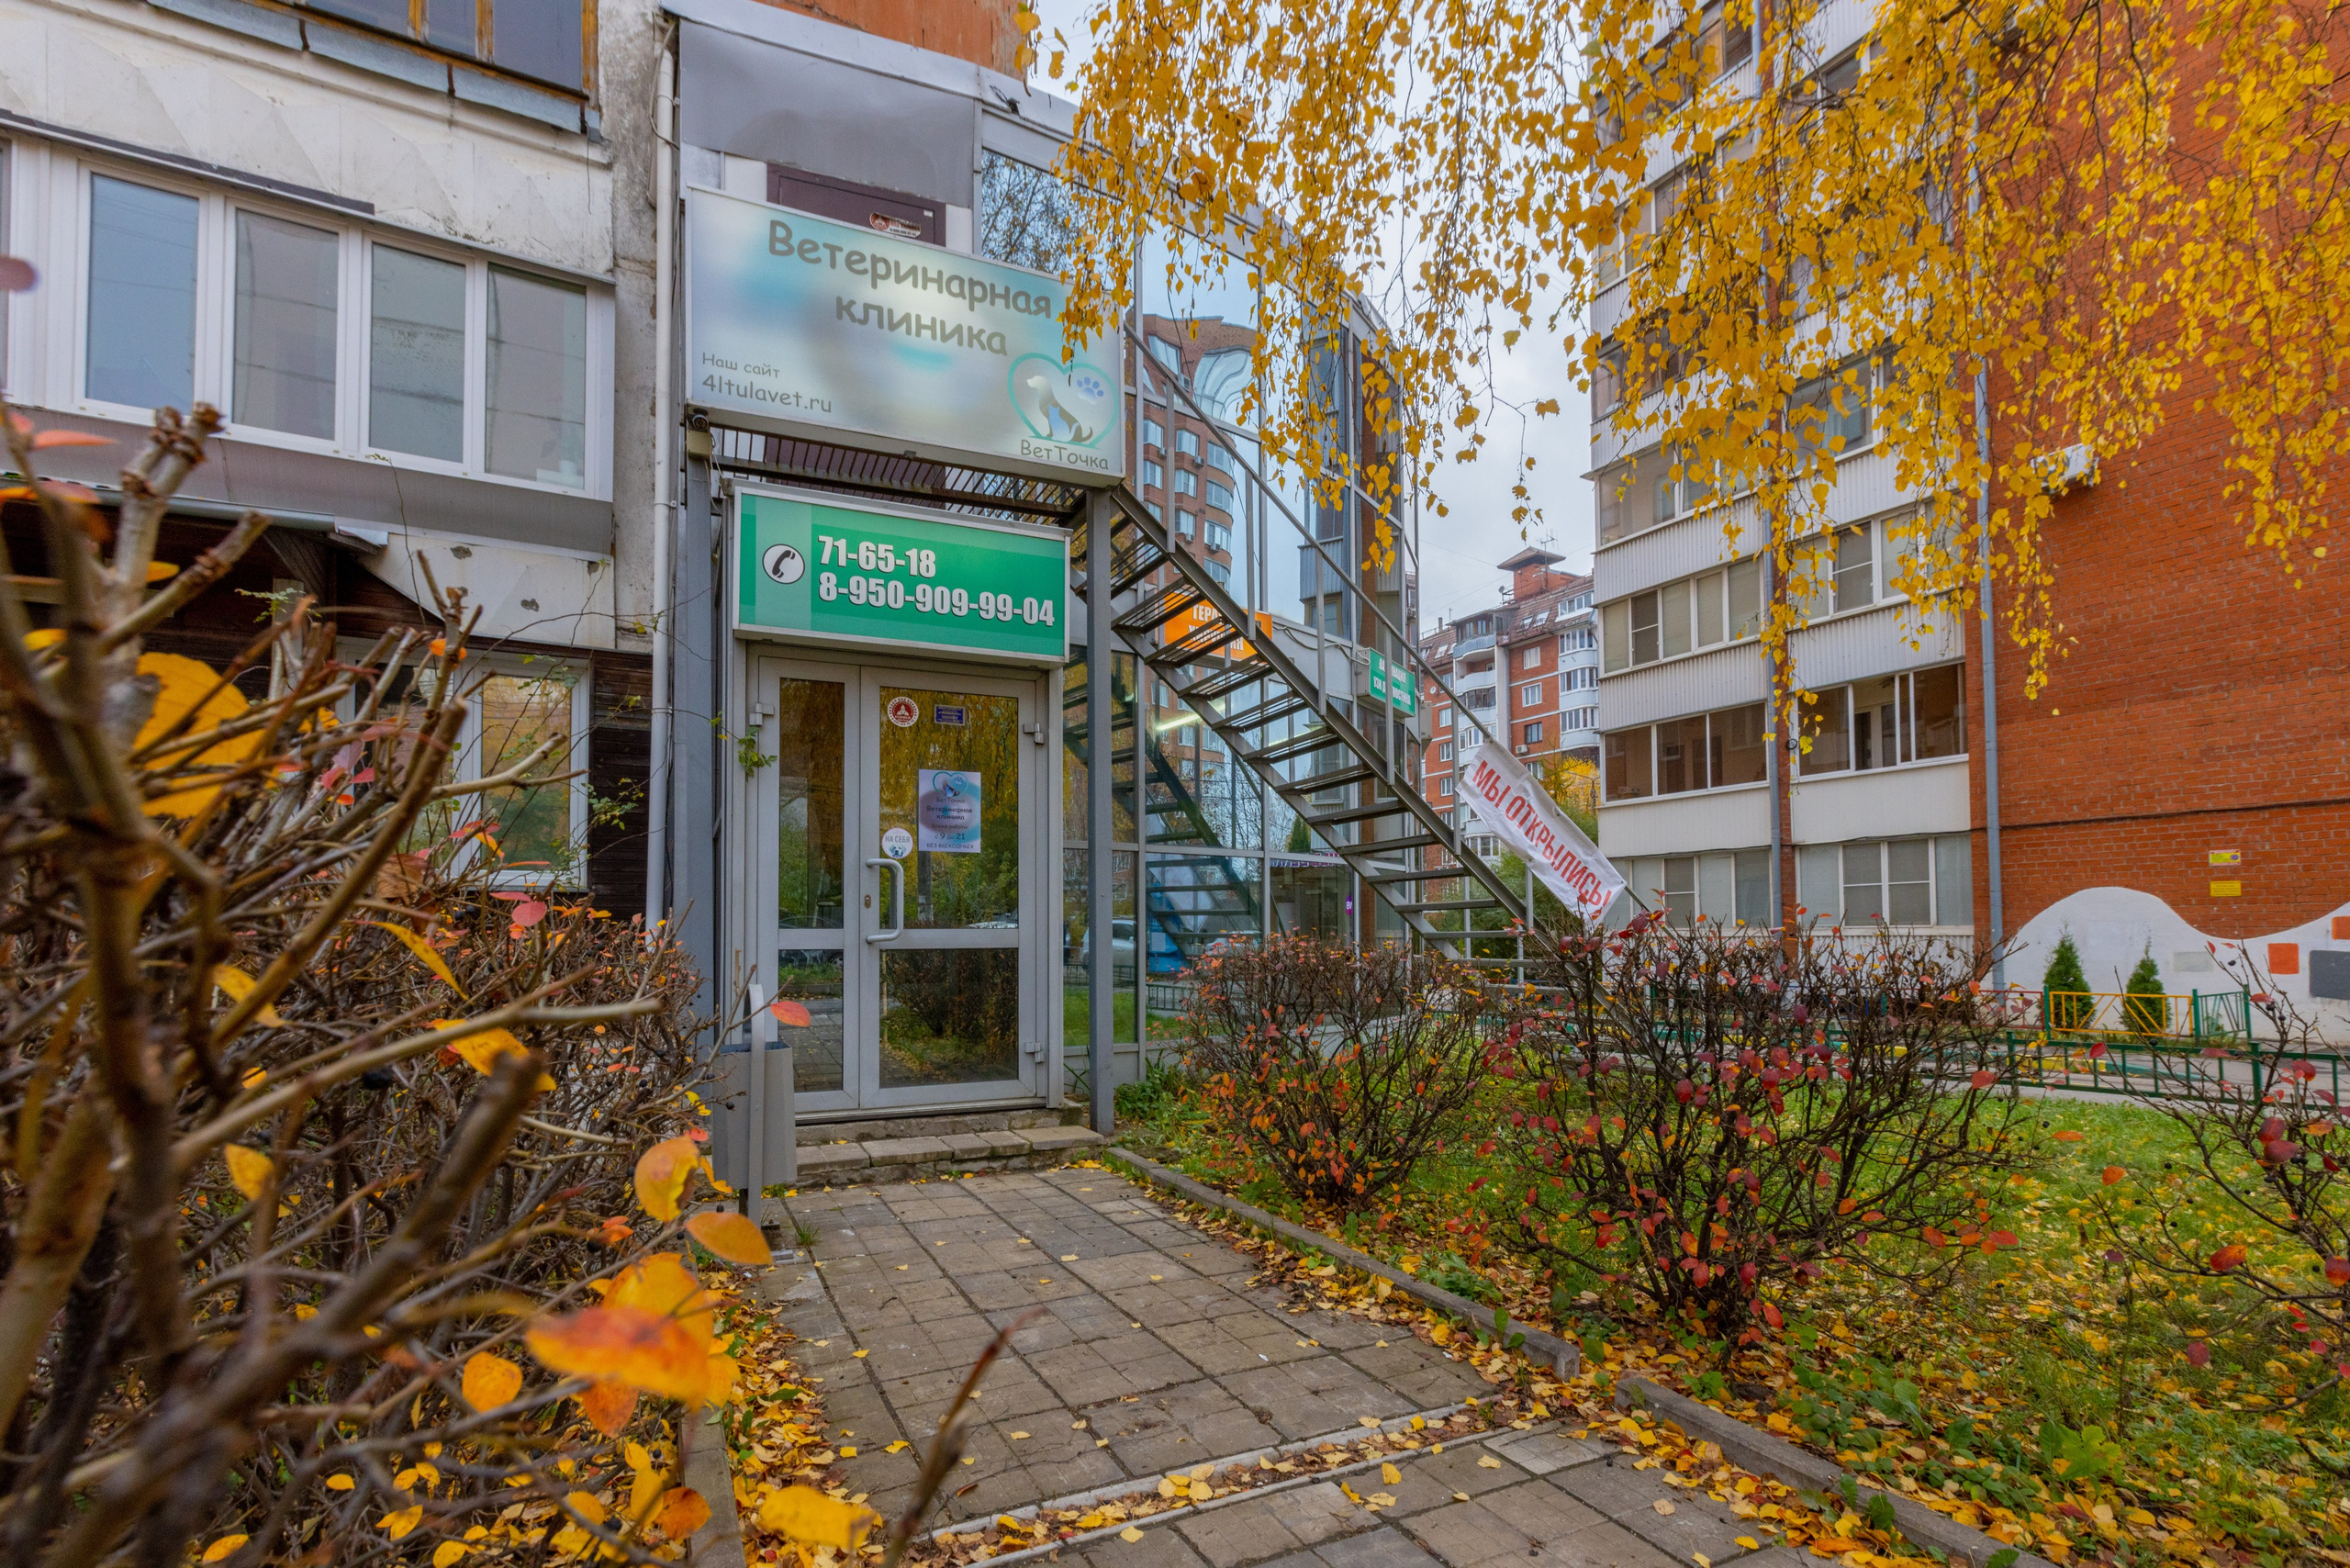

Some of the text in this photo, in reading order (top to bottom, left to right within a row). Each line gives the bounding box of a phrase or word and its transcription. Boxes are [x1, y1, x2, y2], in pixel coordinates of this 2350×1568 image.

[768, 219, 1052, 319] Ветеринарная
[835, 297, 1008, 356] клиника
[702, 352, 780, 378] Наш сайт
[1021, 439, 1109, 471] ВетТочка
[818, 535, 936, 578] 71-65-18
[818, 571, 1056, 627] 8-950-909-99-04
[926, 805, 973, 813] Ветеринарная
[1472, 759, 1613, 908] МЫ ОТКРЫЛИСЬ!
